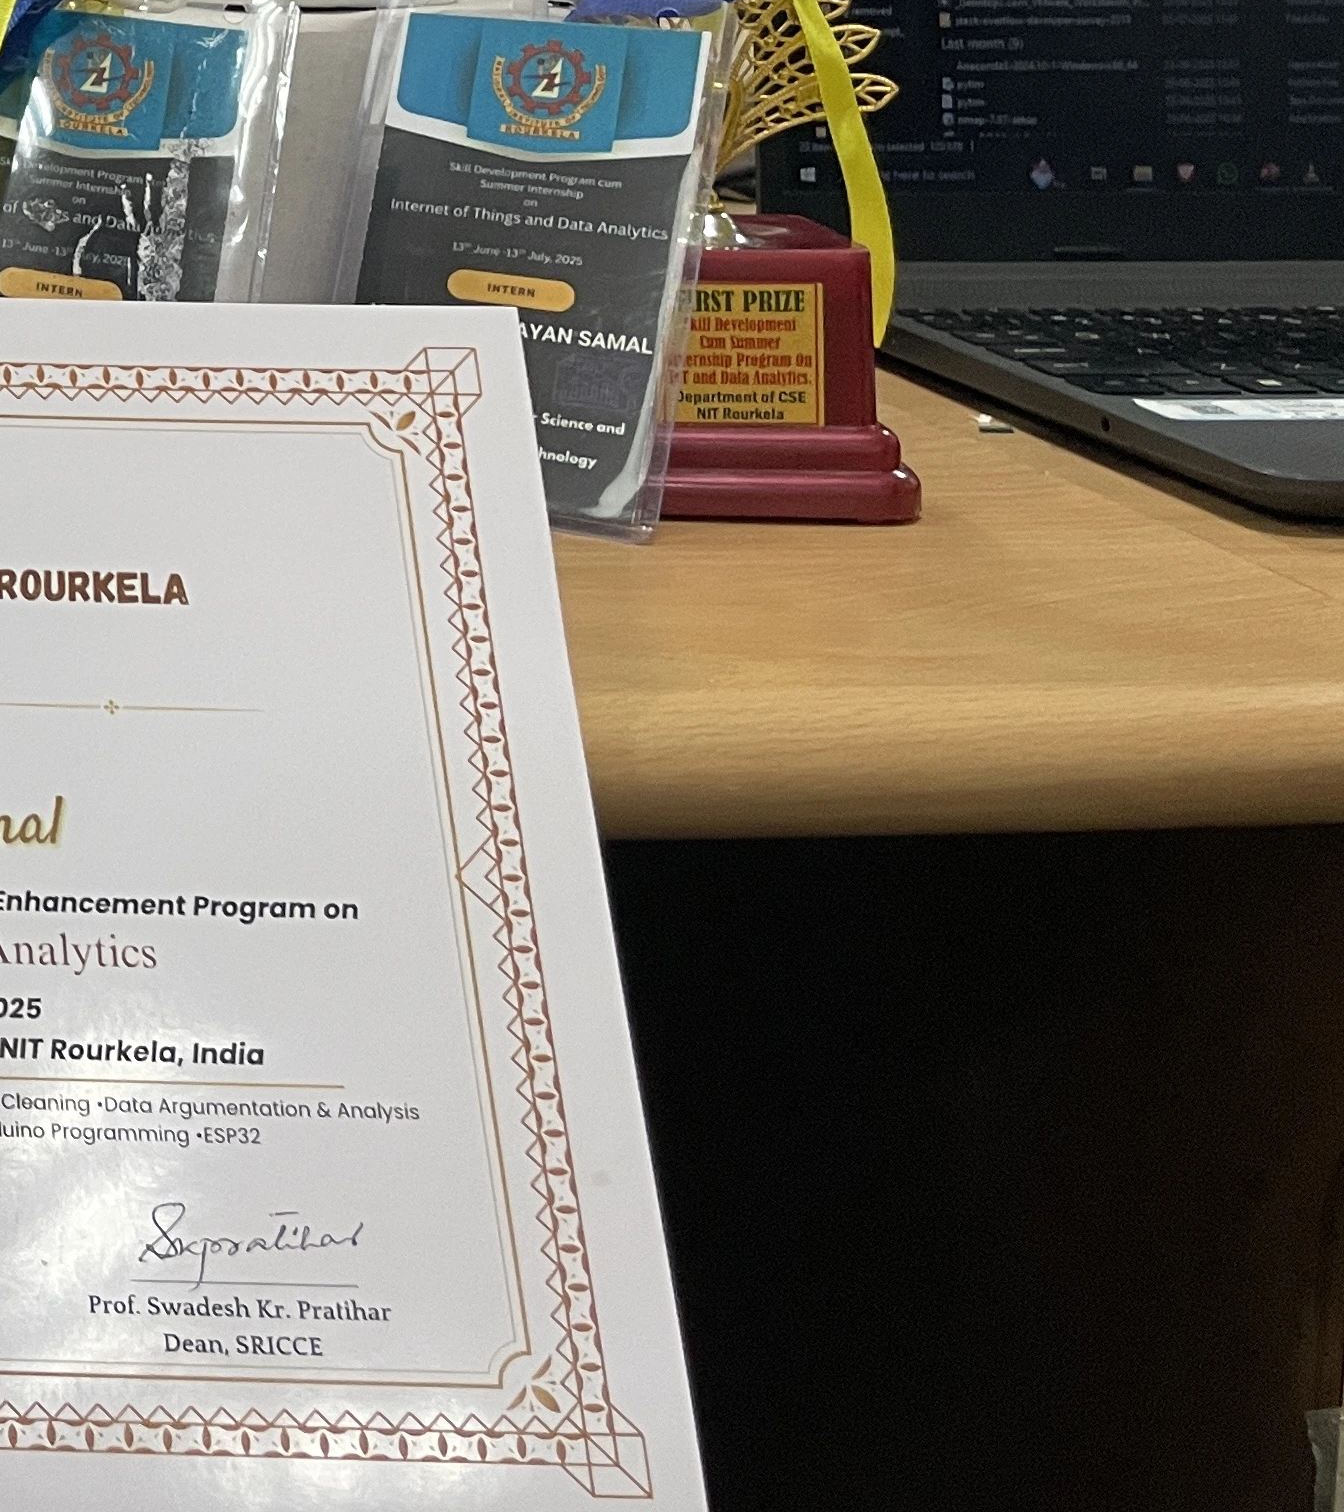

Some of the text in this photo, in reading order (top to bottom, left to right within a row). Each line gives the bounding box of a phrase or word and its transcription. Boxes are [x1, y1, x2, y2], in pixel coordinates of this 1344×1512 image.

[390, 198, 669, 241] Internet of Things and Data Analytics
[487, 283, 536, 299] INTERN
[743, 289, 805, 313] PRIZE
[714, 316, 797, 333] Development
[578, 330, 653, 355] SAMAL
[736, 352, 791, 370] Program
[761, 390, 806, 404] of CSE
[541, 412, 625, 436] Science and
[697, 406, 785, 421] NIT Rourkela
[88, 1294, 392, 1324] Prof. Swadesh Kr. Pratihar
[163, 1333, 324, 1358] Dean, SRICCE
